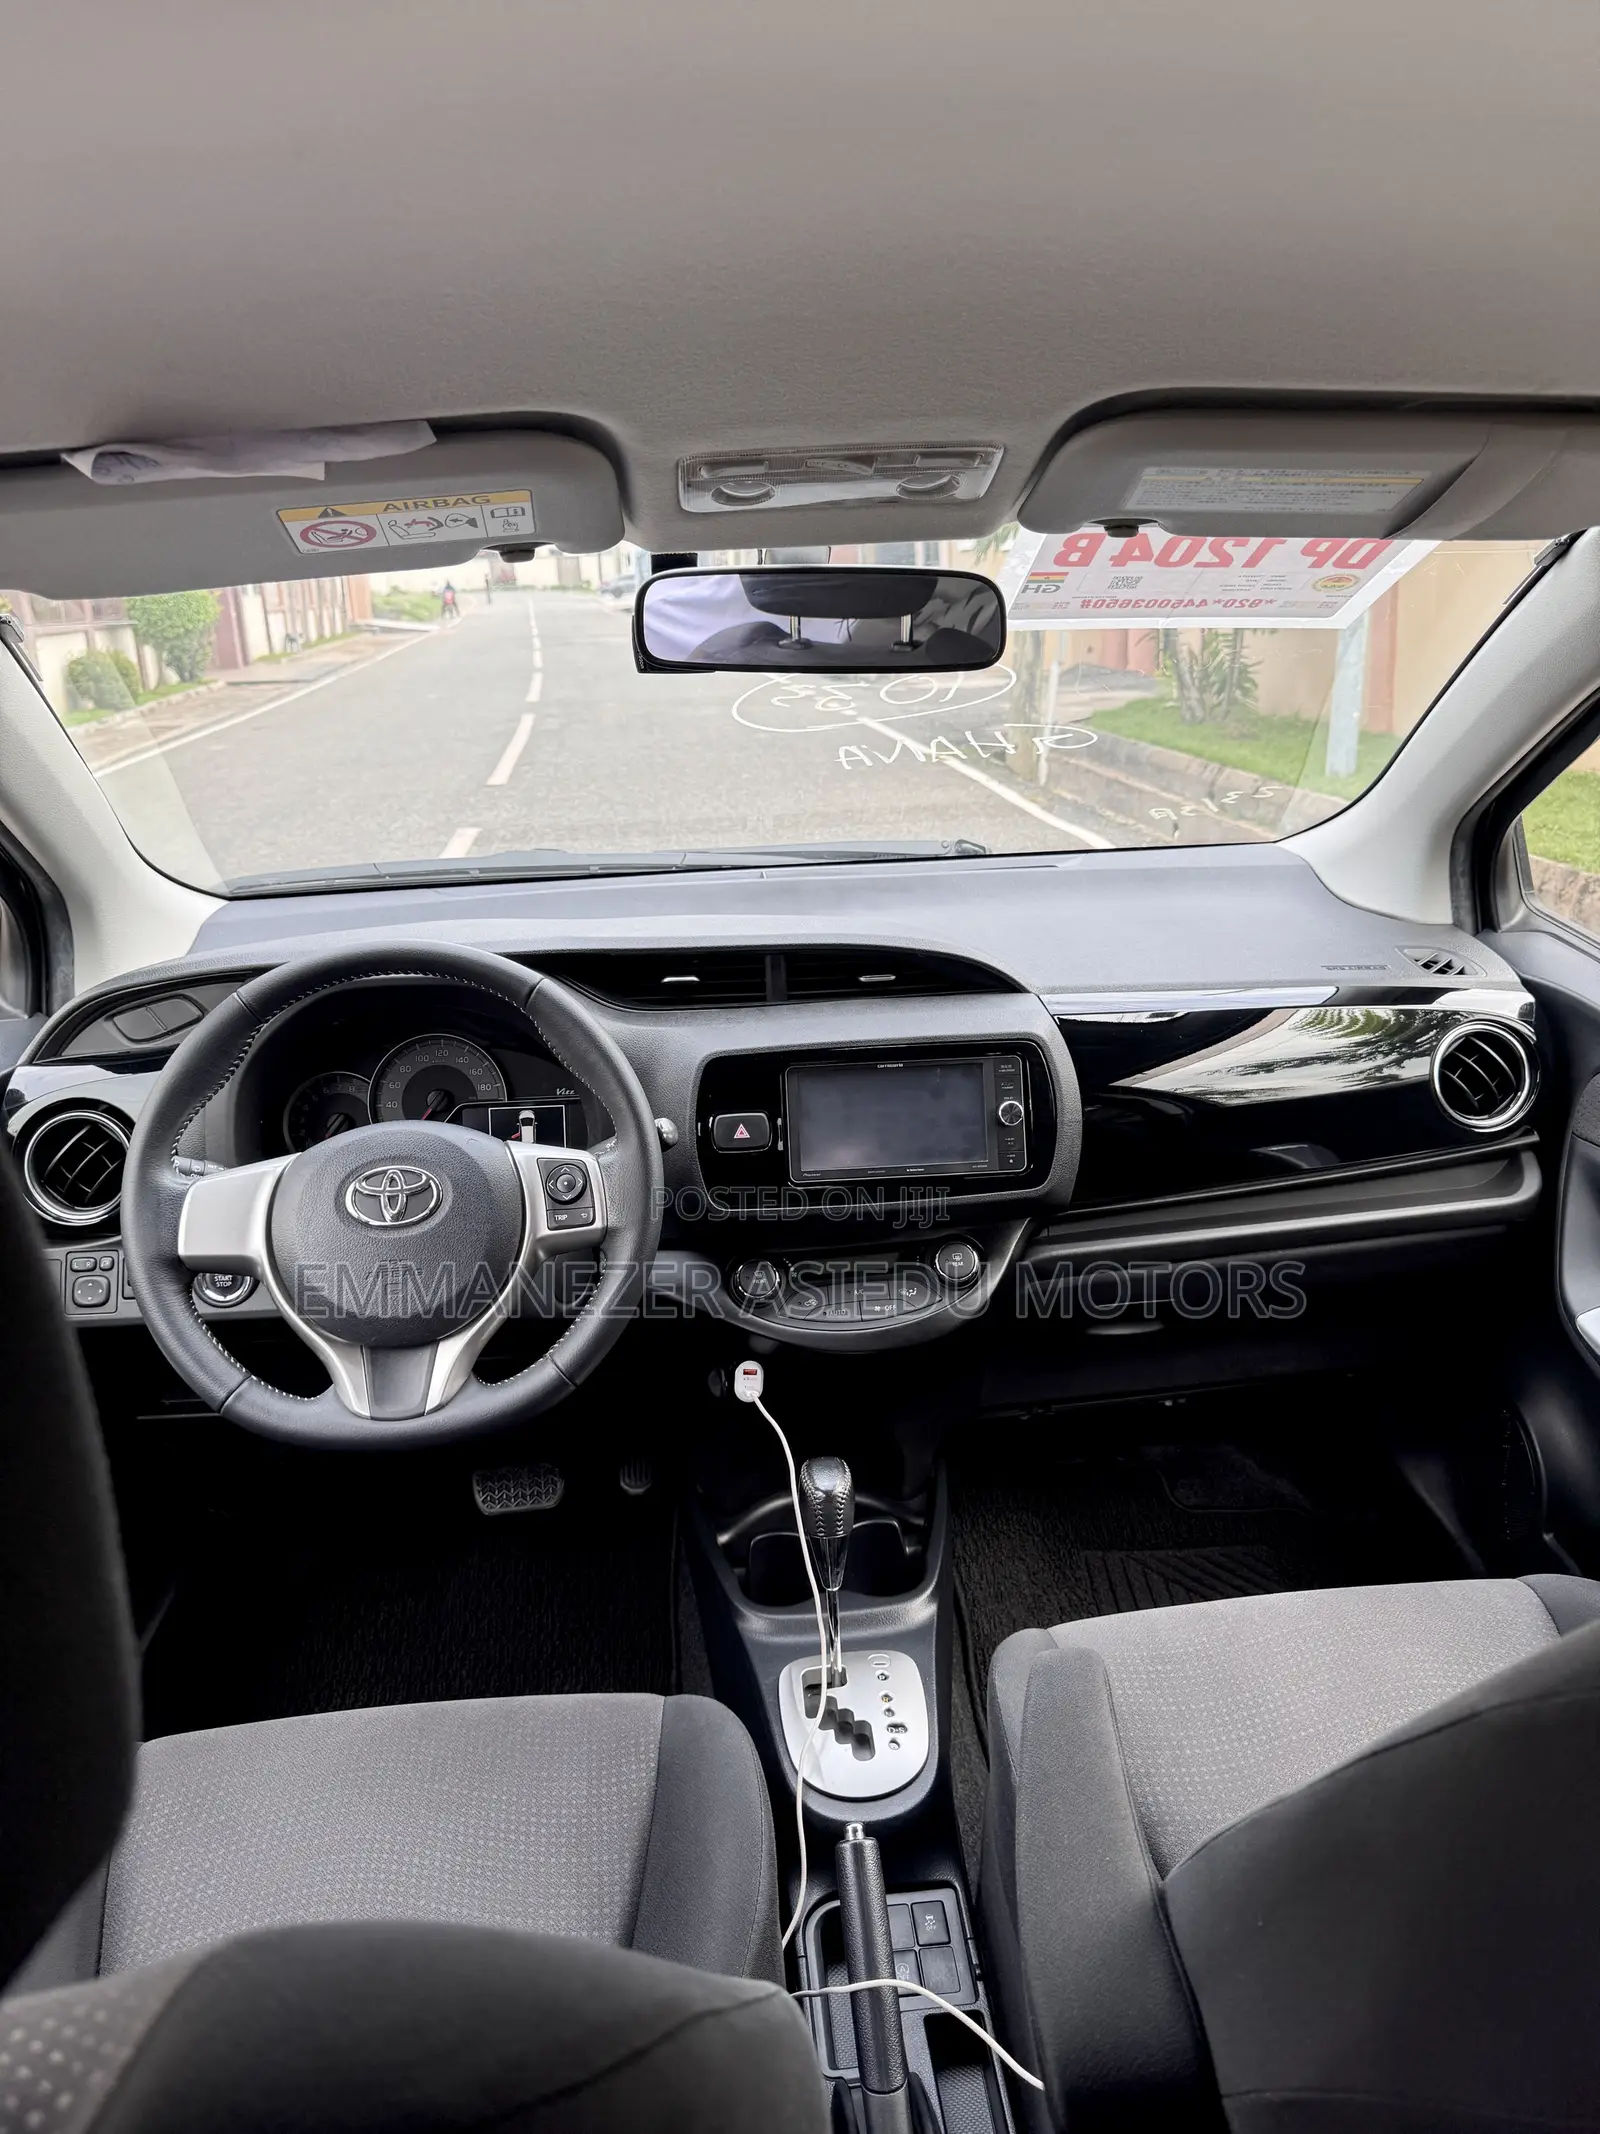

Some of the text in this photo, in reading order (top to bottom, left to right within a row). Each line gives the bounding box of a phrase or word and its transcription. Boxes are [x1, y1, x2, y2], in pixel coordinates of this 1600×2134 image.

[383, 495, 491, 512] AIRBAG
[455, 1056, 469, 1064] 140
[400, 1065, 411, 1073] 80
[469, 1068, 483, 1076] 160
[389, 1081, 400, 1089] 60
[477, 1083, 492, 1091] 180
[386, 1101, 398, 1109] 40
[214, 1273, 233, 1281] START
